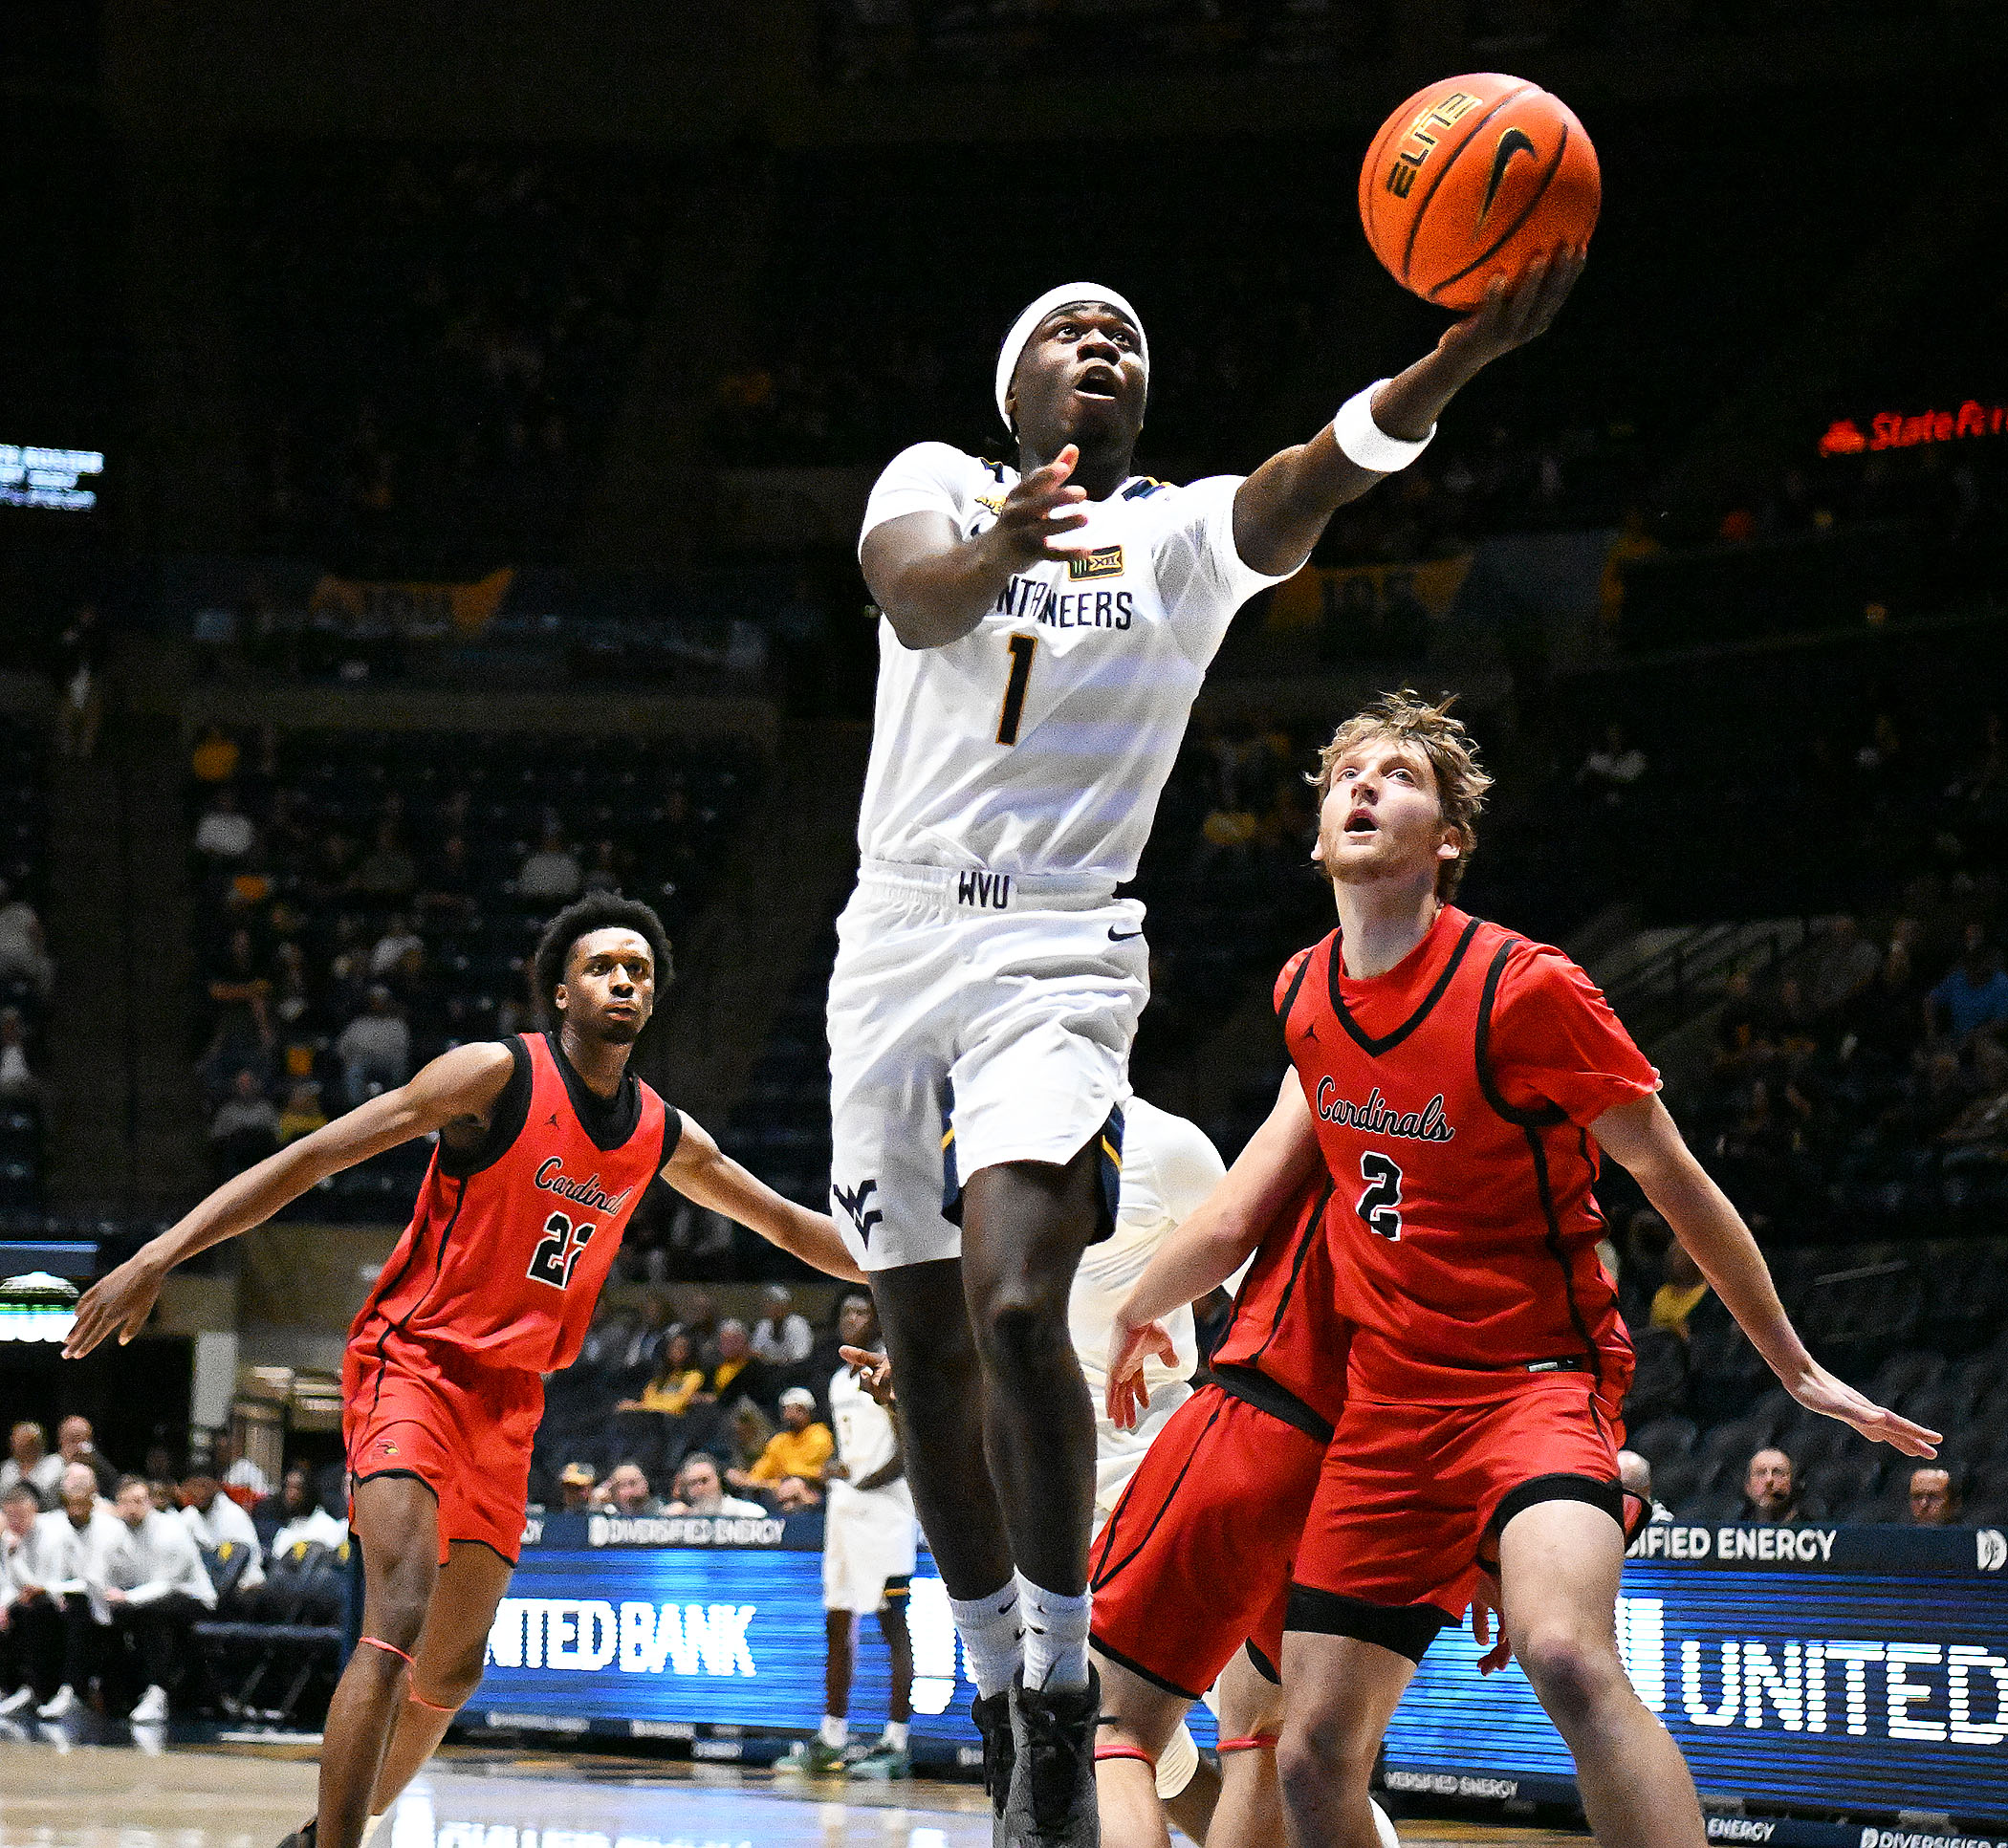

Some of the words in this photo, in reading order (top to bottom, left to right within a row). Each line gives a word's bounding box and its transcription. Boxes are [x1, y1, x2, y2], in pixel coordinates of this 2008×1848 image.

[1386, 92, 1483, 199] ELITE
[995, 631, 1038, 747] 1
[958, 871, 1012, 909] WVU
[1317, 1075, 1456, 1142] Cardinals
[535, 1155, 634, 1216] Cardinal
[1355, 1150, 1404, 1242] 2
[1717, 1527, 1837, 1562] ENERGY
[619, 1600, 757, 1677] BANK
[1680, 1640, 2008, 1745] UNITED
[1707, 1817, 1777, 1842] ENERGY
